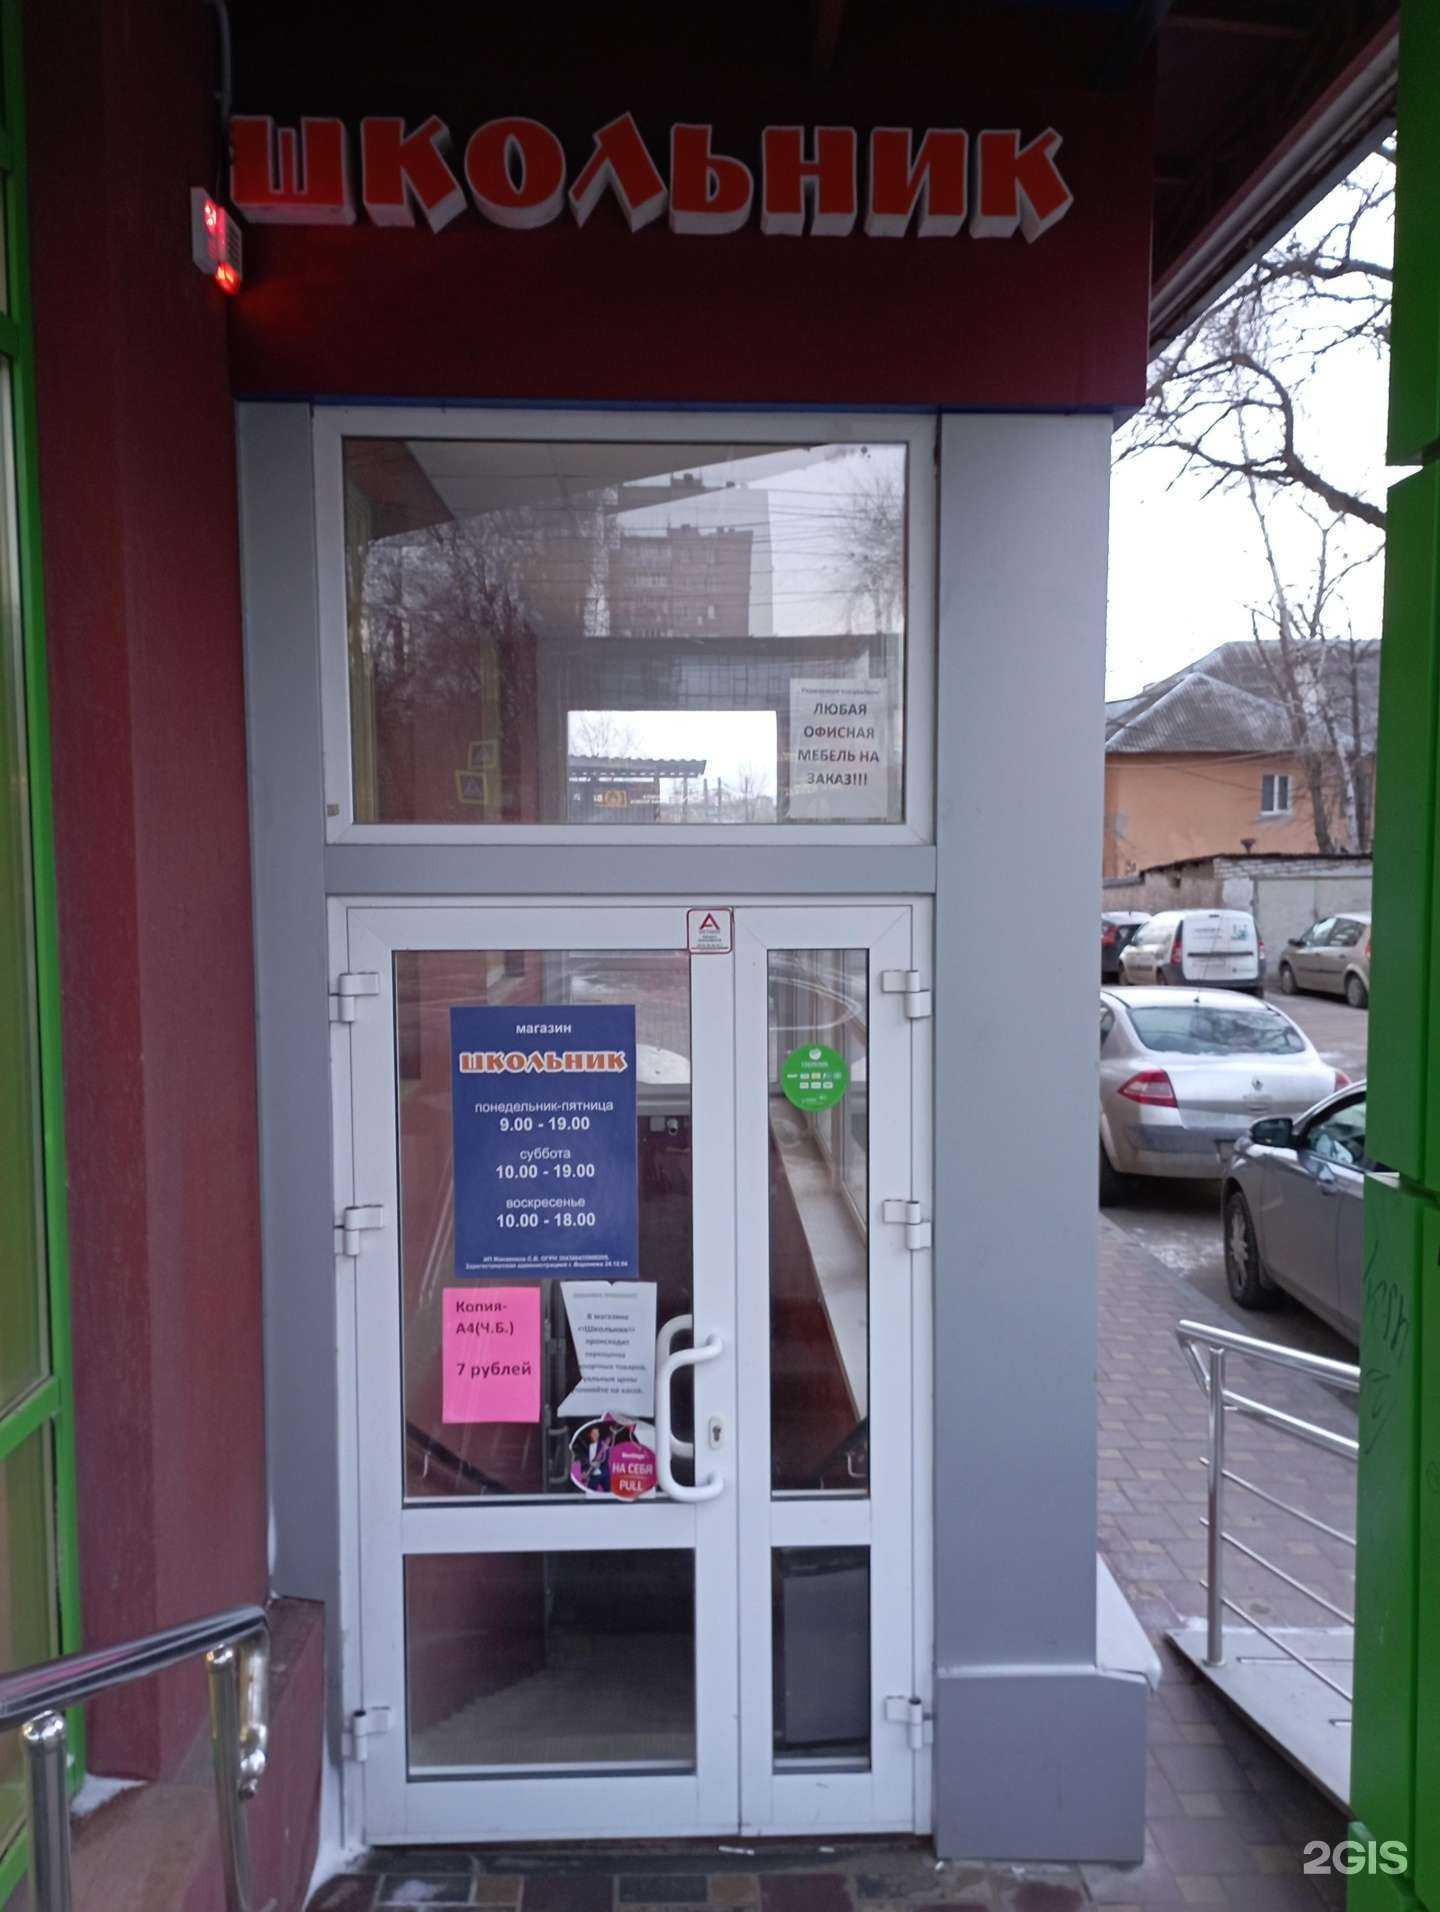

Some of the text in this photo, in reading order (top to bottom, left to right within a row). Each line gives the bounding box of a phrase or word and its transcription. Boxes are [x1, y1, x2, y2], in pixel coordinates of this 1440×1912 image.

[229, 110, 1075, 243] ШКОЛЬНИК
[813, 702, 868, 716] ЛЮБАЯ
[803, 725, 875, 740] ОФИСНАЯ
[797, 748, 880, 763] МЕБЕЛЬ НА
[807, 772, 868, 786] ЗАКАЗ!!!
[515, 1023, 572, 1034] магазин
[459, 1051, 629, 1074] ШКОЛЬНИК
[474, 1100, 615, 1114] понедельник-пятница
[499, 1117, 533, 1132] 9.00
[548, 1116, 591, 1131] 19.00
[519, 1147, 571, 1162] суббота
[495, 1164, 538, 1180] 10.00
[553, 1163, 596, 1179] 19.00
[505, 1197, 586, 1210] воскресенье
[496, 1213, 539, 1228] 10.00
[554, 1212, 596, 1227] 18.00
[456, 1300, 508, 1314] Копия-
[456, 1361, 532, 1379] 7 рублей
[611, 1462, 654, 1476] НА СЕБЯ
[619, 1479, 642, 1492] PULL
